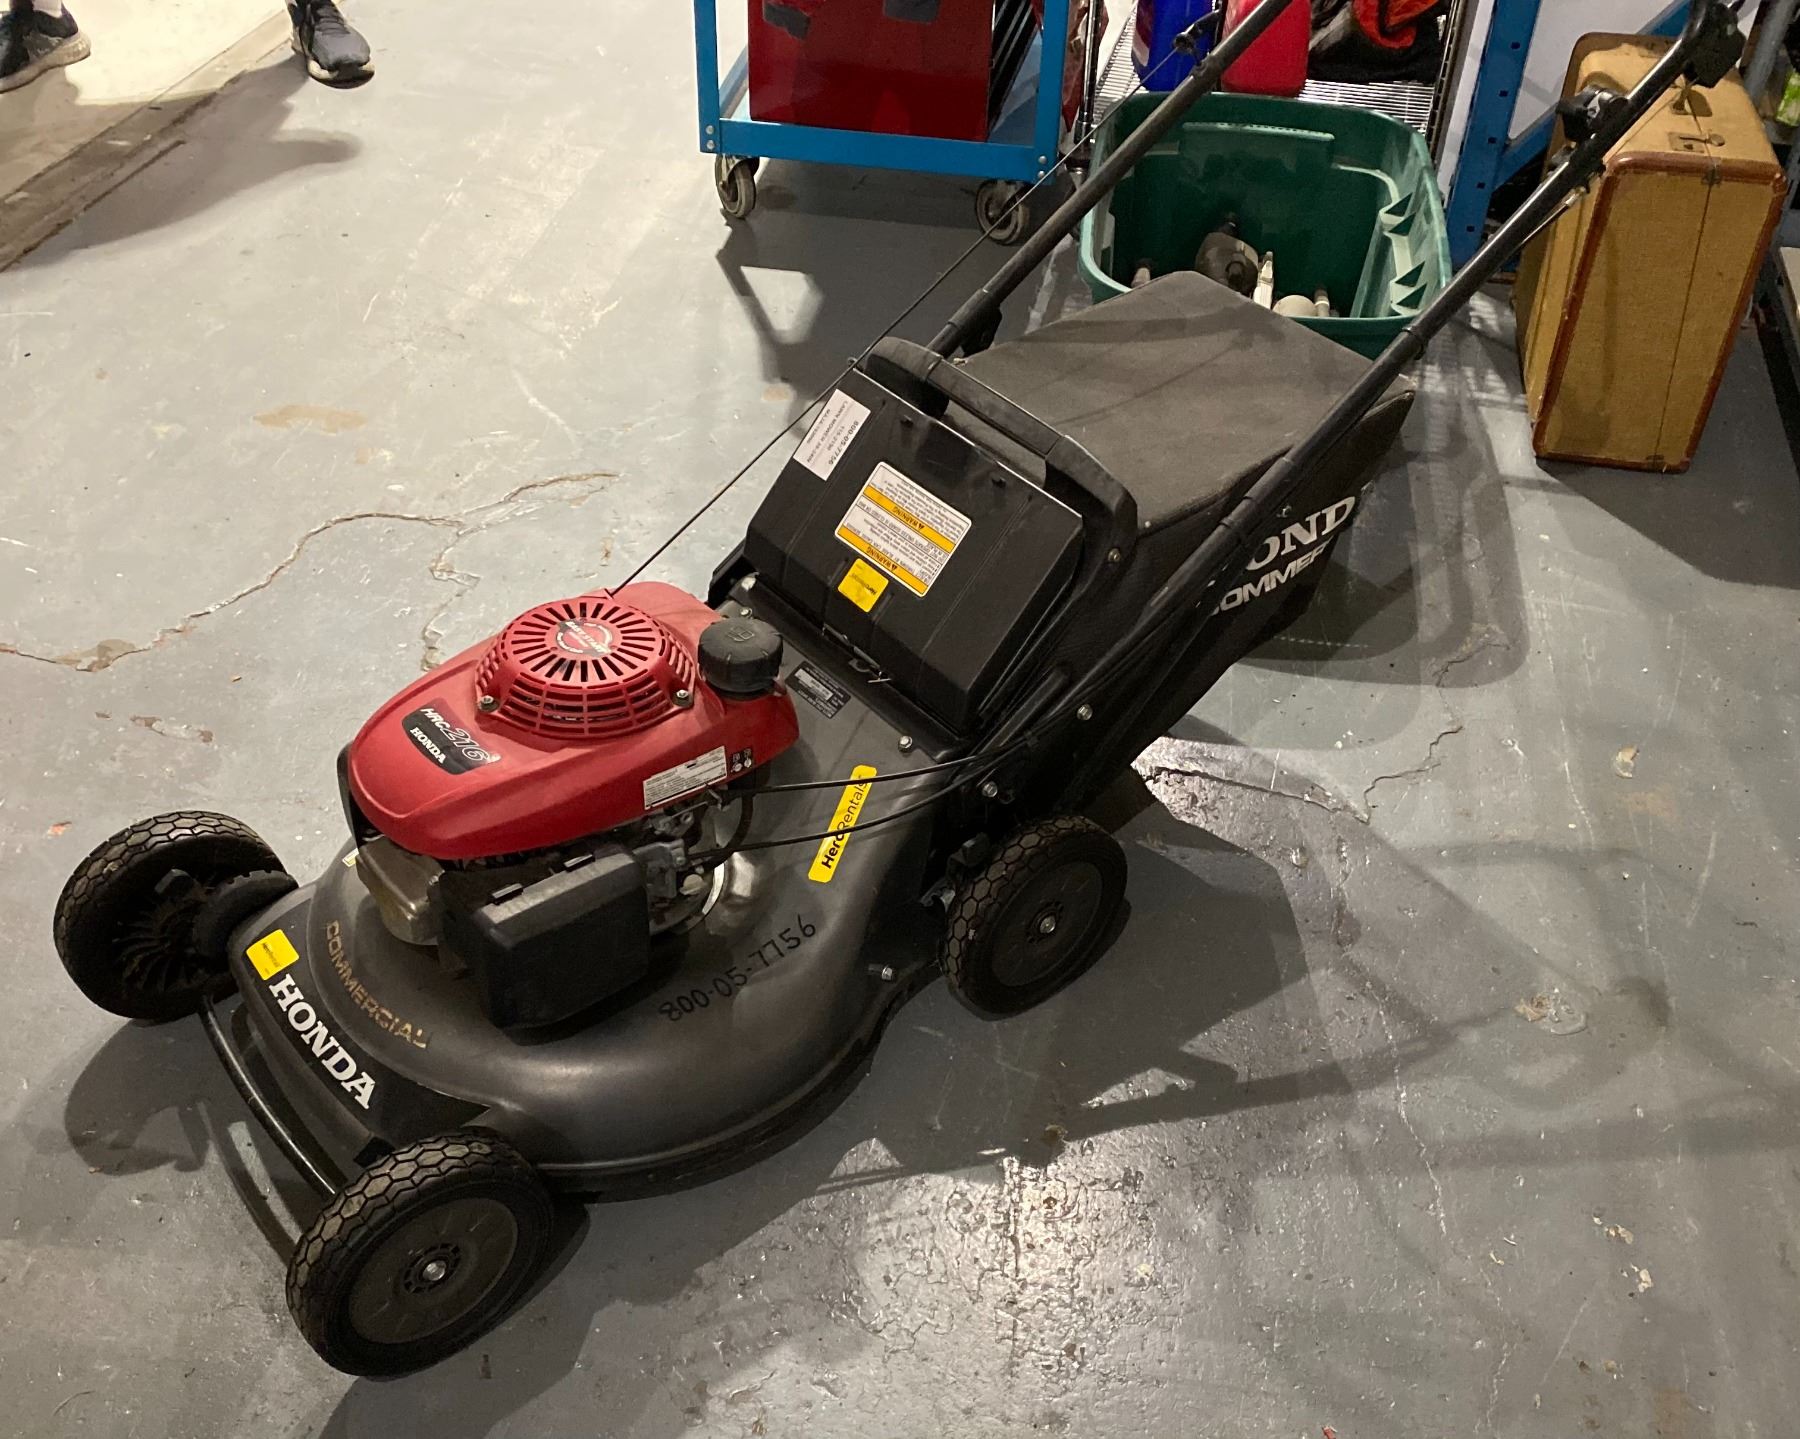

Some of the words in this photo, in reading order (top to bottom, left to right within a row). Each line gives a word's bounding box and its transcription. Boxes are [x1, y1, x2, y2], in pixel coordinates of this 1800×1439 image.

[819, 417, 837, 442] MOWER
[893, 506, 918, 528] WARNING
[866, 547, 891, 568] WARNING
[410, 727, 446, 764] HONDA
[326, 920, 427, 1049] COMMERCIAL
[659, 914, 816, 1022] 800-05-7756
[268, 973, 376, 1110] HONDA
